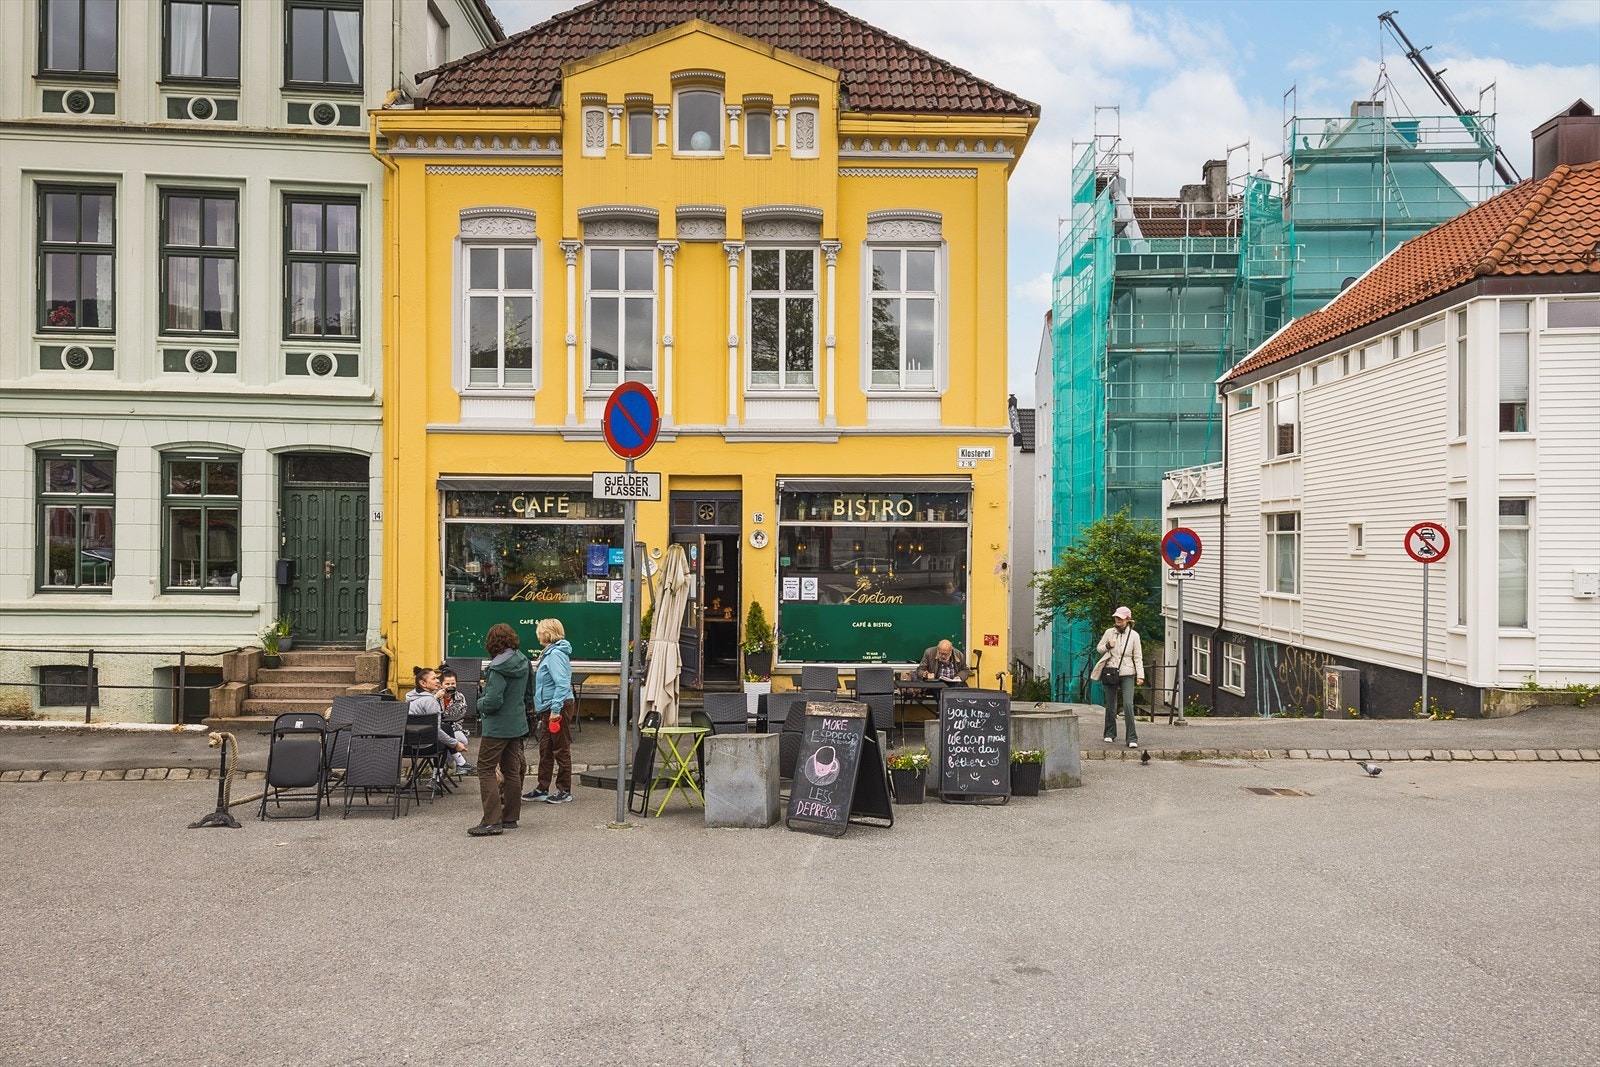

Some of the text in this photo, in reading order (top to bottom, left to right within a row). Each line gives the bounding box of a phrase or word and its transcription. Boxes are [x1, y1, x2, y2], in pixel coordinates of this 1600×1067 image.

[960, 449, 991, 458] Klosteret
[604, 476, 649, 487] GJELDER
[604, 486, 652, 497] PLASSEN.
[511, 493, 570, 513] CAFÉ
[833, 499, 913, 516] BISTRO
[373, 512, 381, 520] 14
[755, 514, 763, 522] 16
[822, 718, 849, 731] MORE
[963, 734, 986, 745] can
[948, 743, 1000, 760] your day
[808, 786, 833, 805] LESS
[795, 800, 838, 821] DEPRESSO
